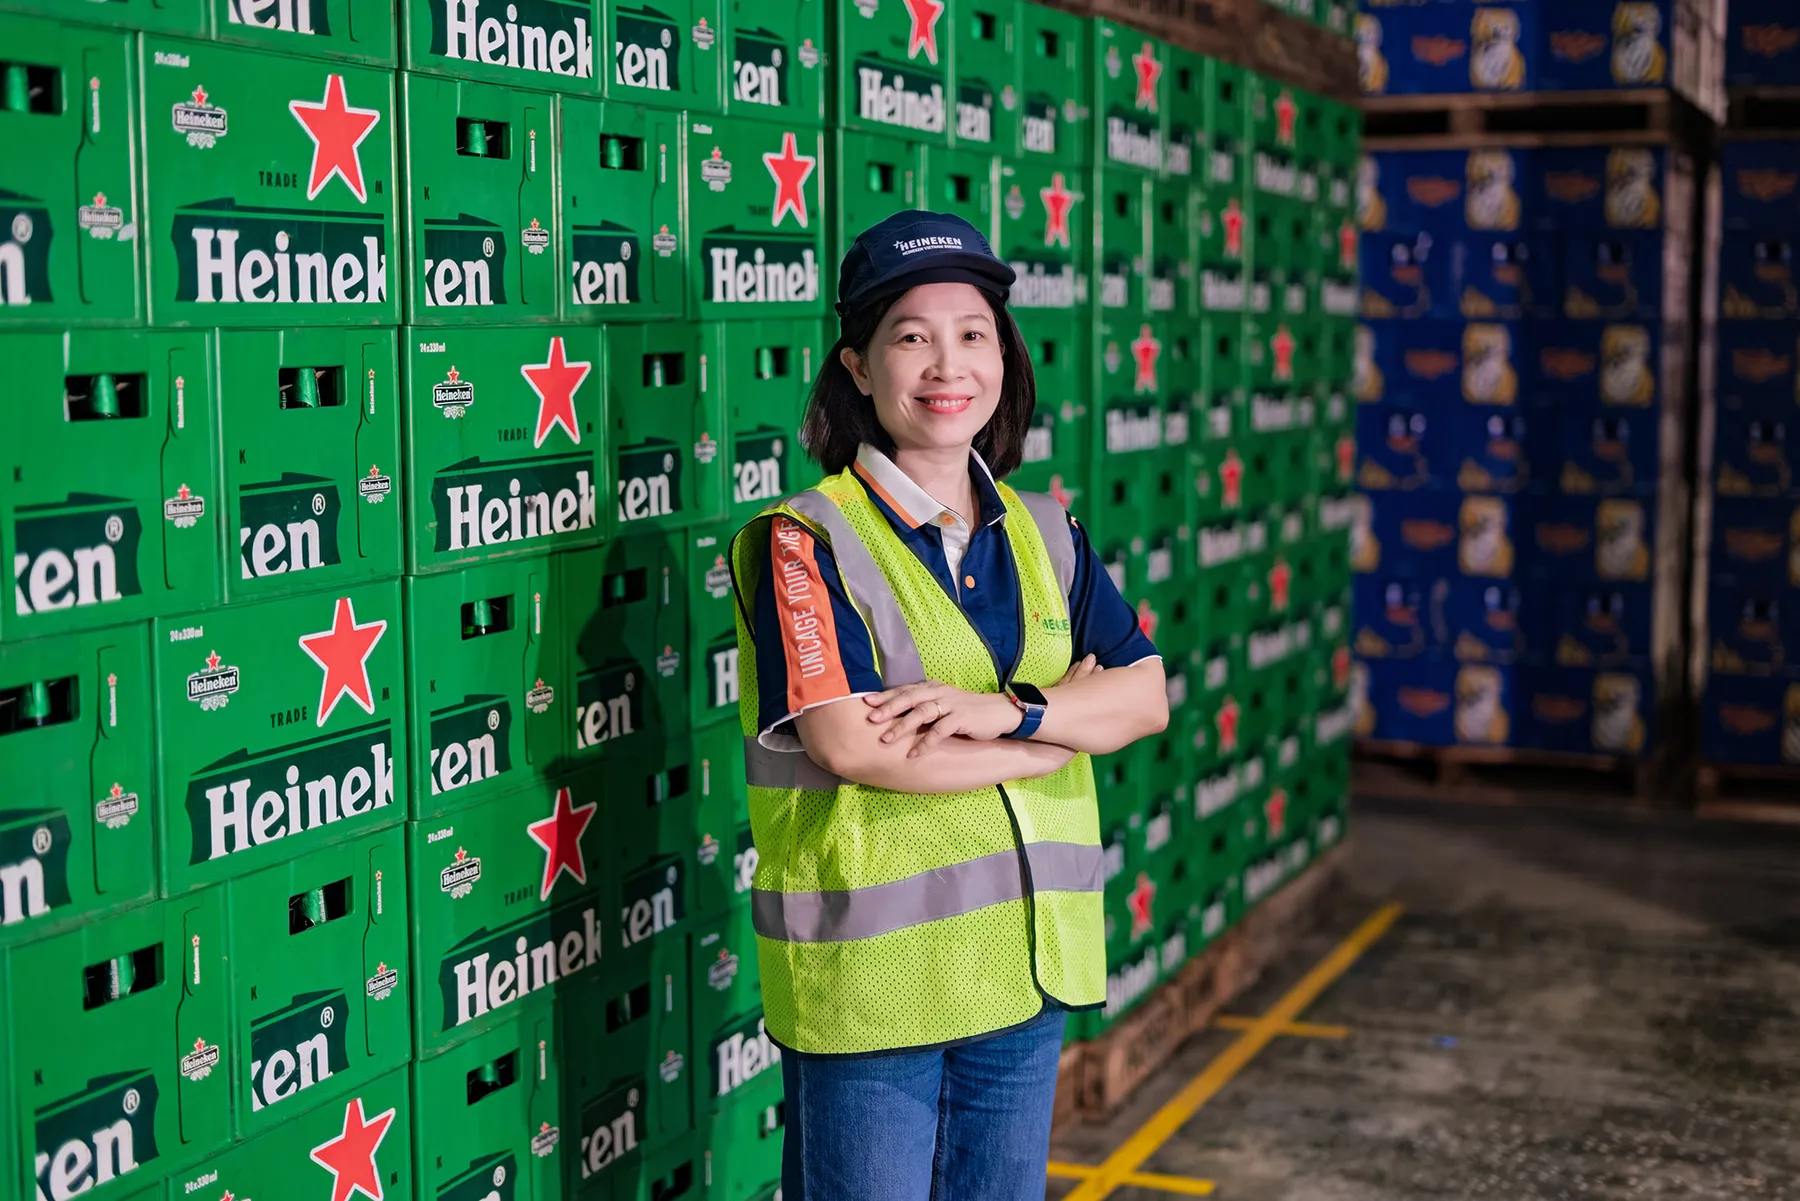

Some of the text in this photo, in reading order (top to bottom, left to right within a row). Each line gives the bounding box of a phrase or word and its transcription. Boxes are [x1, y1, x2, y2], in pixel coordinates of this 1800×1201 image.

[258, 171, 383, 195] TRADE M
[424, 187, 431, 201] K
[900, 236, 962, 251] HEINEKEN
[436, 388, 473, 402] Heineken
[498, 427, 528, 443] TRADE
[239, 449, 246, 465] K
[784, 558, 812, 605] YOUR
[793, 605, 825, 679] UNCAGE
[190, 672, 236, 695] Heineken
[430, 679, 436, 693] K
[270, 706, 308, 728] TRADE
[443, 863, 479, 886] Heineken
[250, 986, 258, 1001] K
[34, 1069, 44, 1086] K
